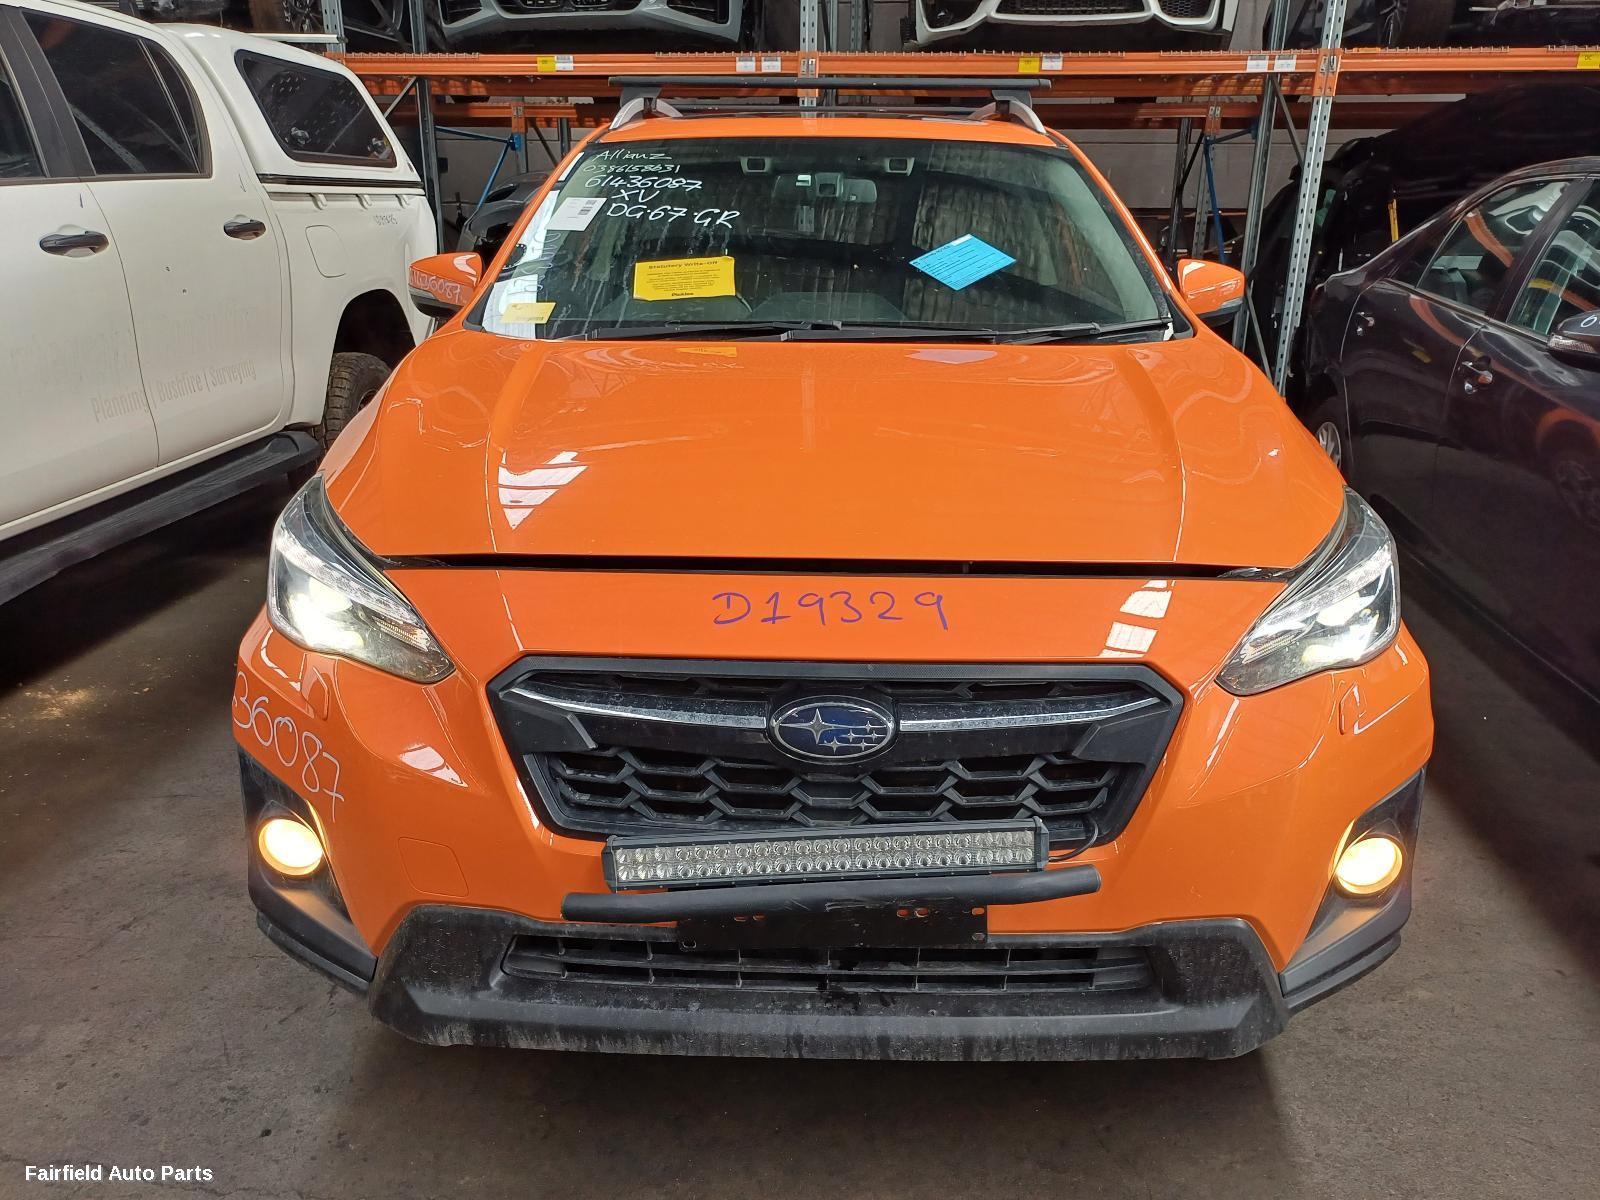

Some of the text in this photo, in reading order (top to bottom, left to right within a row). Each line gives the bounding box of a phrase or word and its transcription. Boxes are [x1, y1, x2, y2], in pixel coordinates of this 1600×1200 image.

[592, 148, 673, 162] Allianz
[585, 175, 703, 192] 61436087
[611, 189, 660, 203] XV
[90, 391, 149, 423] Planning
[157, 374, 203, 403] Bushfire
[211, 359, 257, 387] Surveying
[712, 591, 949, 631] D19329
